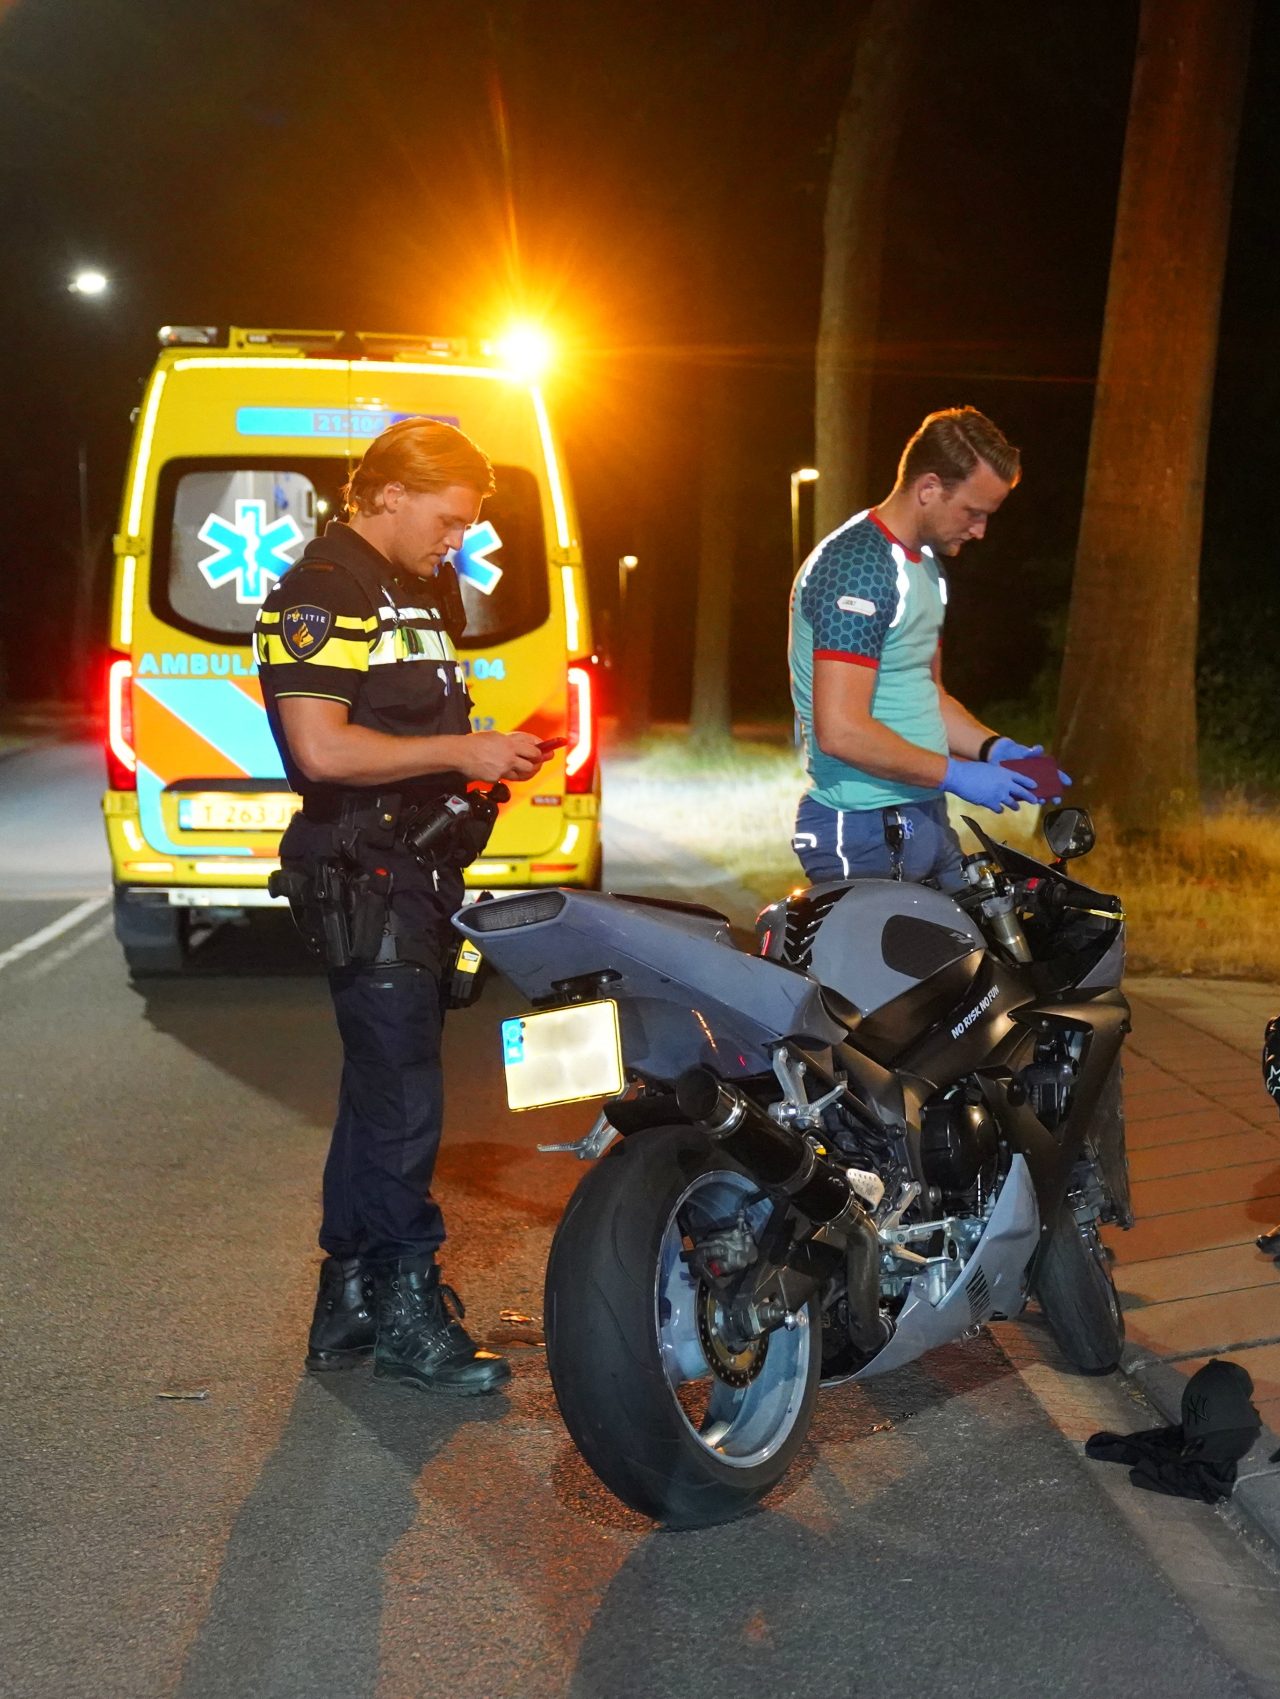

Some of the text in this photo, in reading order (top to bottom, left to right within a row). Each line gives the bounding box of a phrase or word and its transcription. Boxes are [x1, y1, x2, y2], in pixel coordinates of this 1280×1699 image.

[462, 658, 506, 680] 104
[951, 984, 1000, 1040] NO RISK NO FUN
